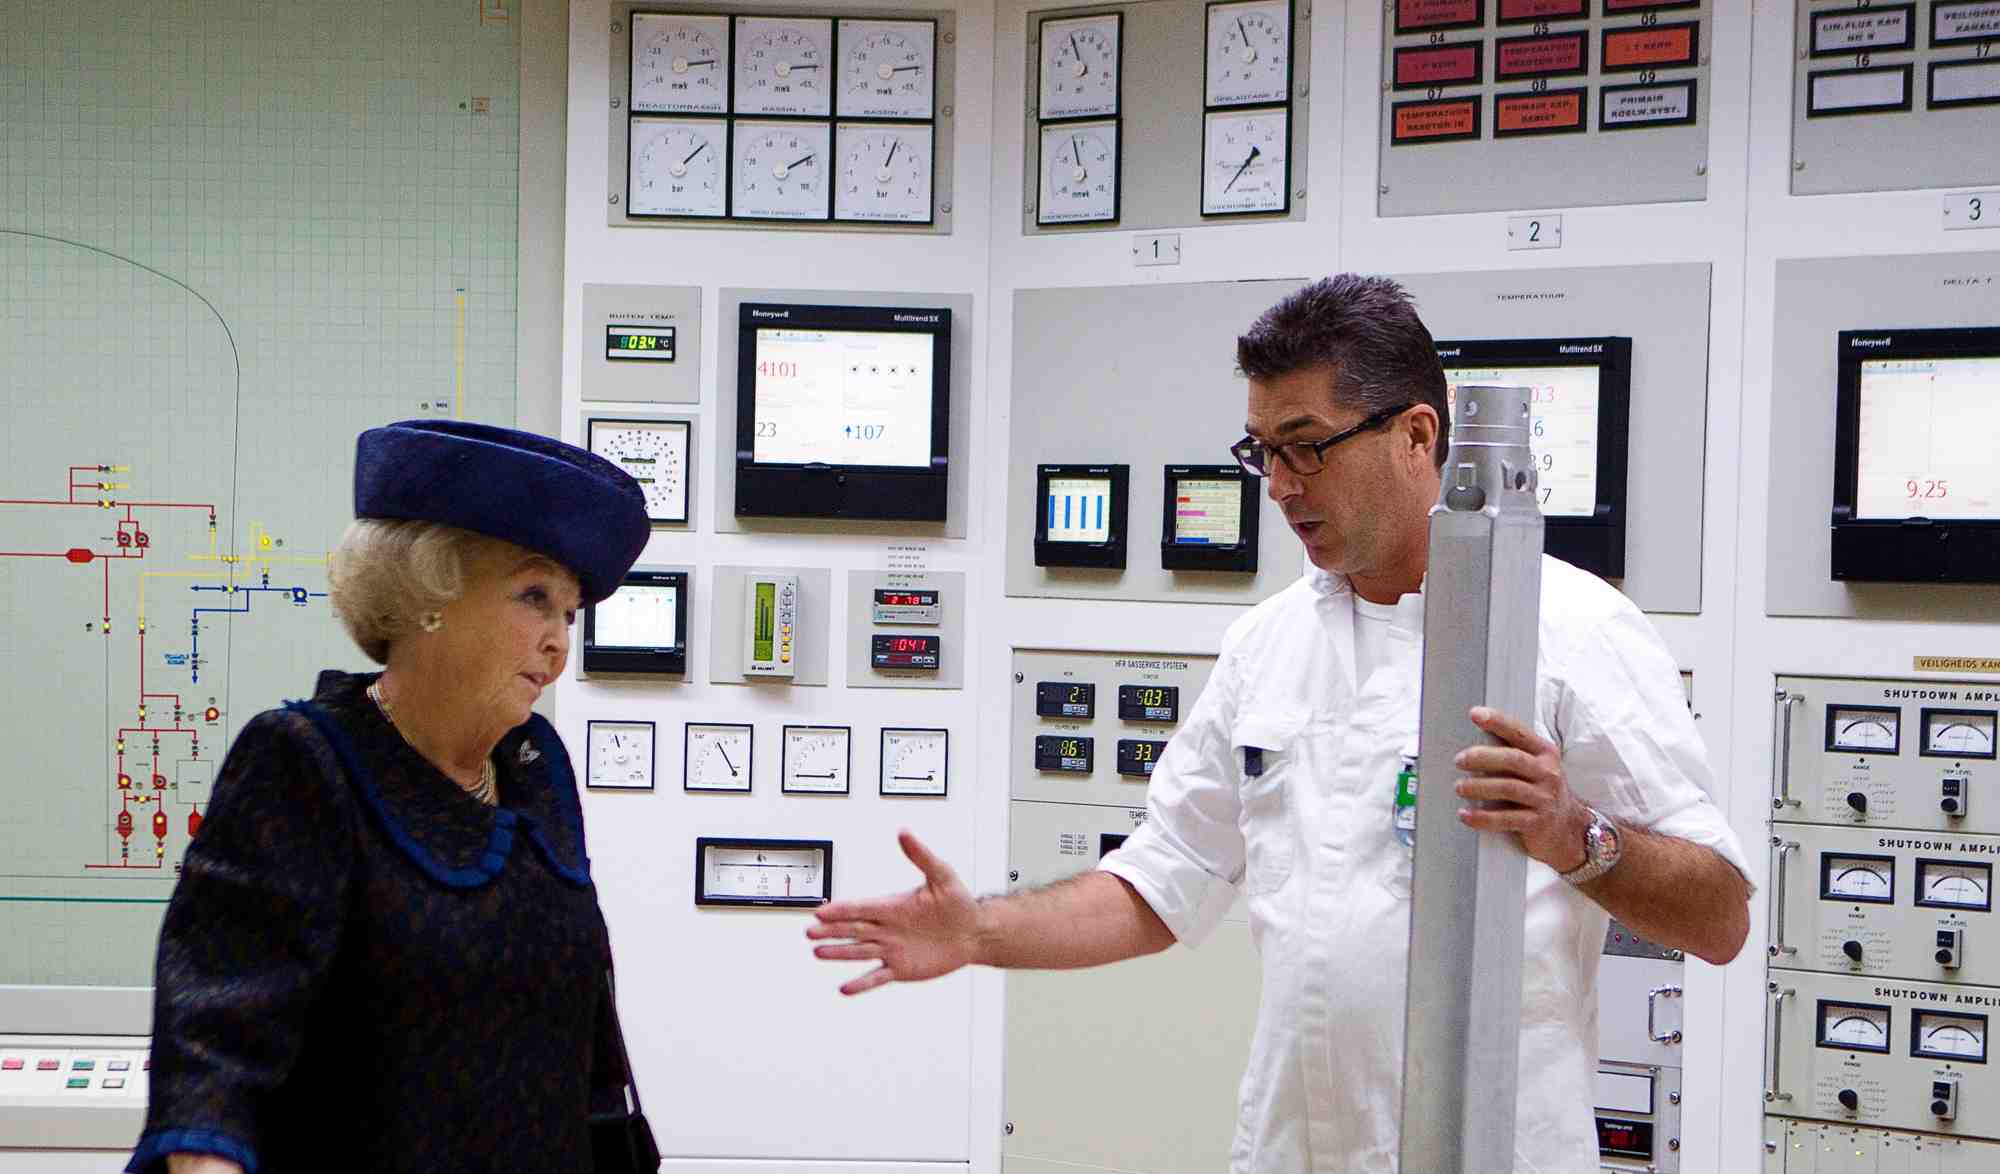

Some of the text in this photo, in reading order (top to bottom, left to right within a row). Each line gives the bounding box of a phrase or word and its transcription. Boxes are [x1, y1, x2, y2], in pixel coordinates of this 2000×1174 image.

[1641, 13, 1657, 25] 06
[1533, 23, 1549, 35] 05
[1430, 32, 1445, 44] 04
[1975, 43, 1992, 58] 17
[1855, 52, 1870, 67] 16
[1639, 71, 1656, 83] 09
[1531, 79, 1548, 92] 08
[1427, 87, 1444, 100] 07
[1969, 198, 1982, 221] 3
[1529, 220, 1541, 242] 2
[1153, 239, 1159, 259] 1
[752, 310, 940, 323] Honeywell Multitrend SX
[1559, 344, 1592, 354] Multitrend
[1593, 343, 1604, 353] SX
[1851, 337, 1891, 349] Honeywell
[756, 360, 799, 378] 4101
[756, 421, 778, 439] 23
[855, 424, 886, 441] 107
[1906, 479, 1948, 499] 9.25
[1920, 659, 1977, 669] VEILIGHEIDS
[1070, 686, 1079, 703] 2
[1884, 689, 1957, 701] SHUTDOWN
[1879, 838, 1952, 851] SHUTDOWN
[1874, 987, 2000, 1006] SHUTDOWN AMPLI
